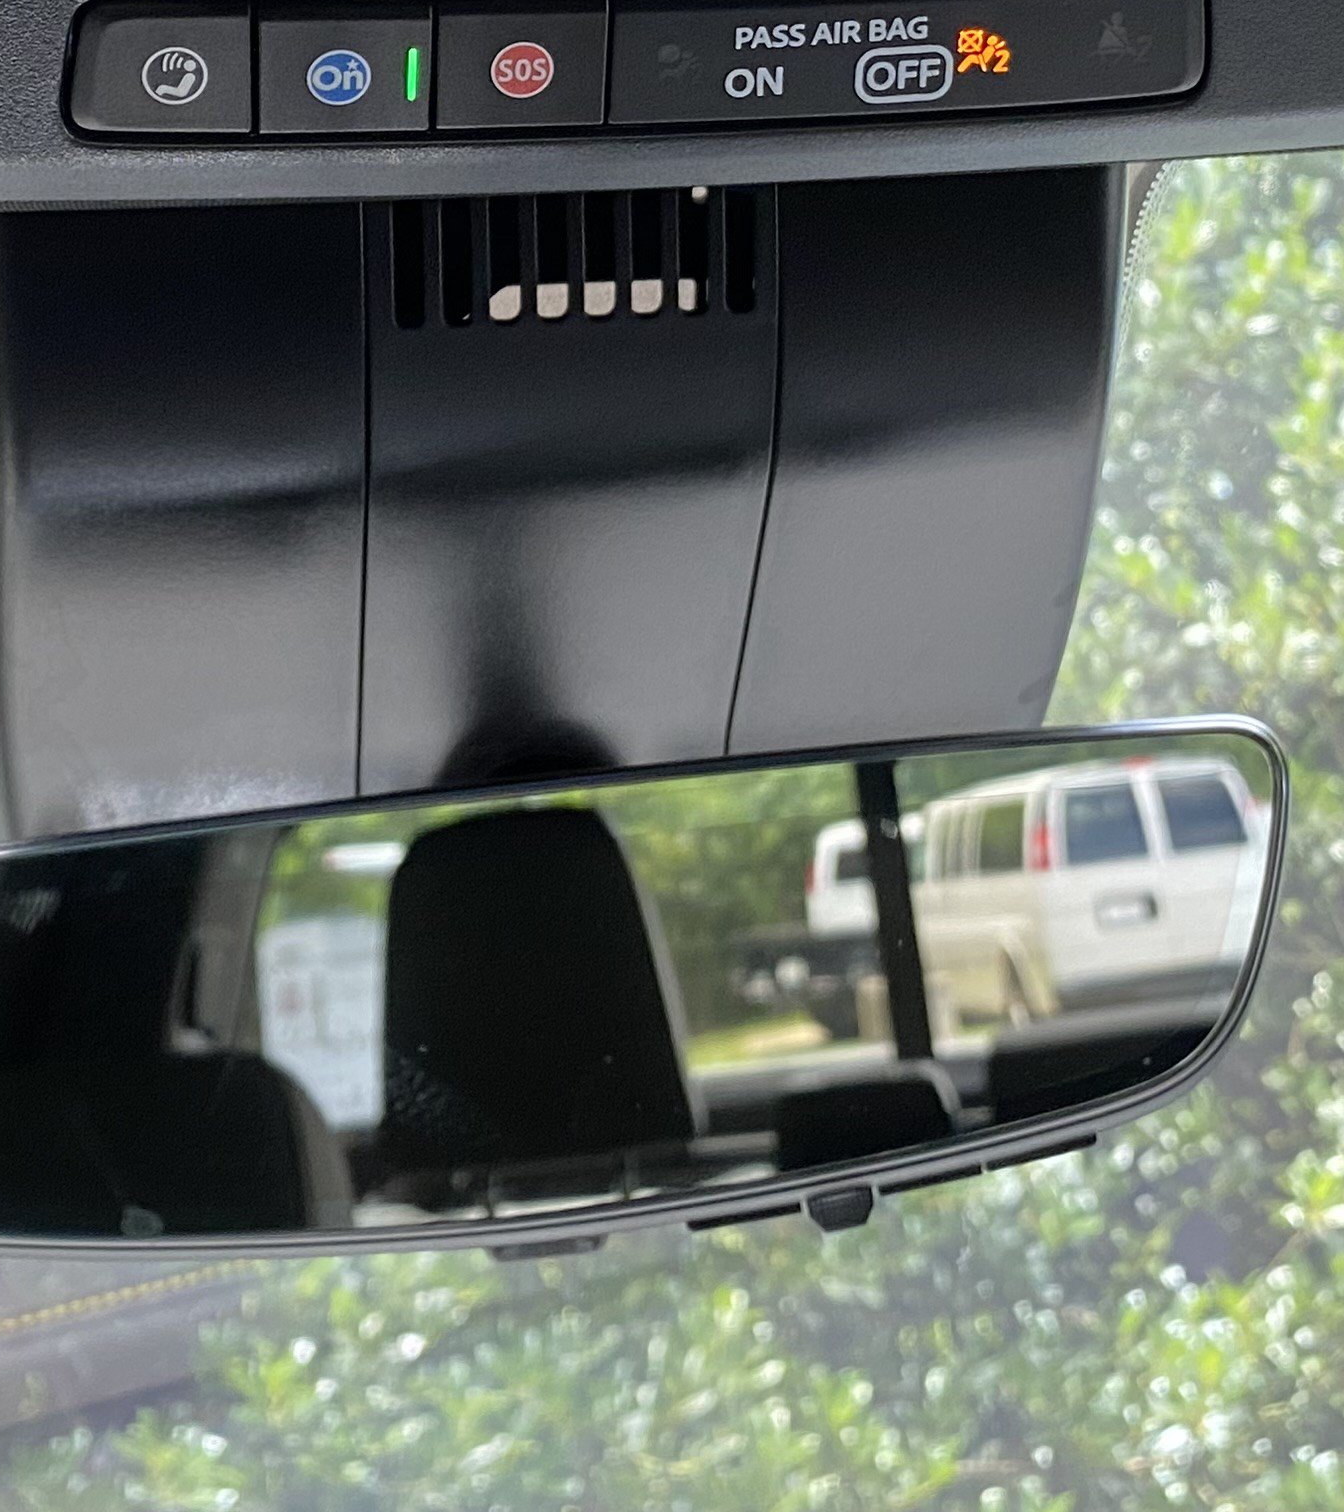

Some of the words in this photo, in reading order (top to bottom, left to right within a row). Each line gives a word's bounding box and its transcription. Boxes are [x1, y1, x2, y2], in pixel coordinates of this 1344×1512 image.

[734, 22, 806, 50] PASS
[810, 19, 862, 46] AIR
[867, 15, 930, 43] BAG
[496, 56, 549, 83] SOS
[723, 66, 785, 99] ON
[864, 58, 942, 92] OFF
